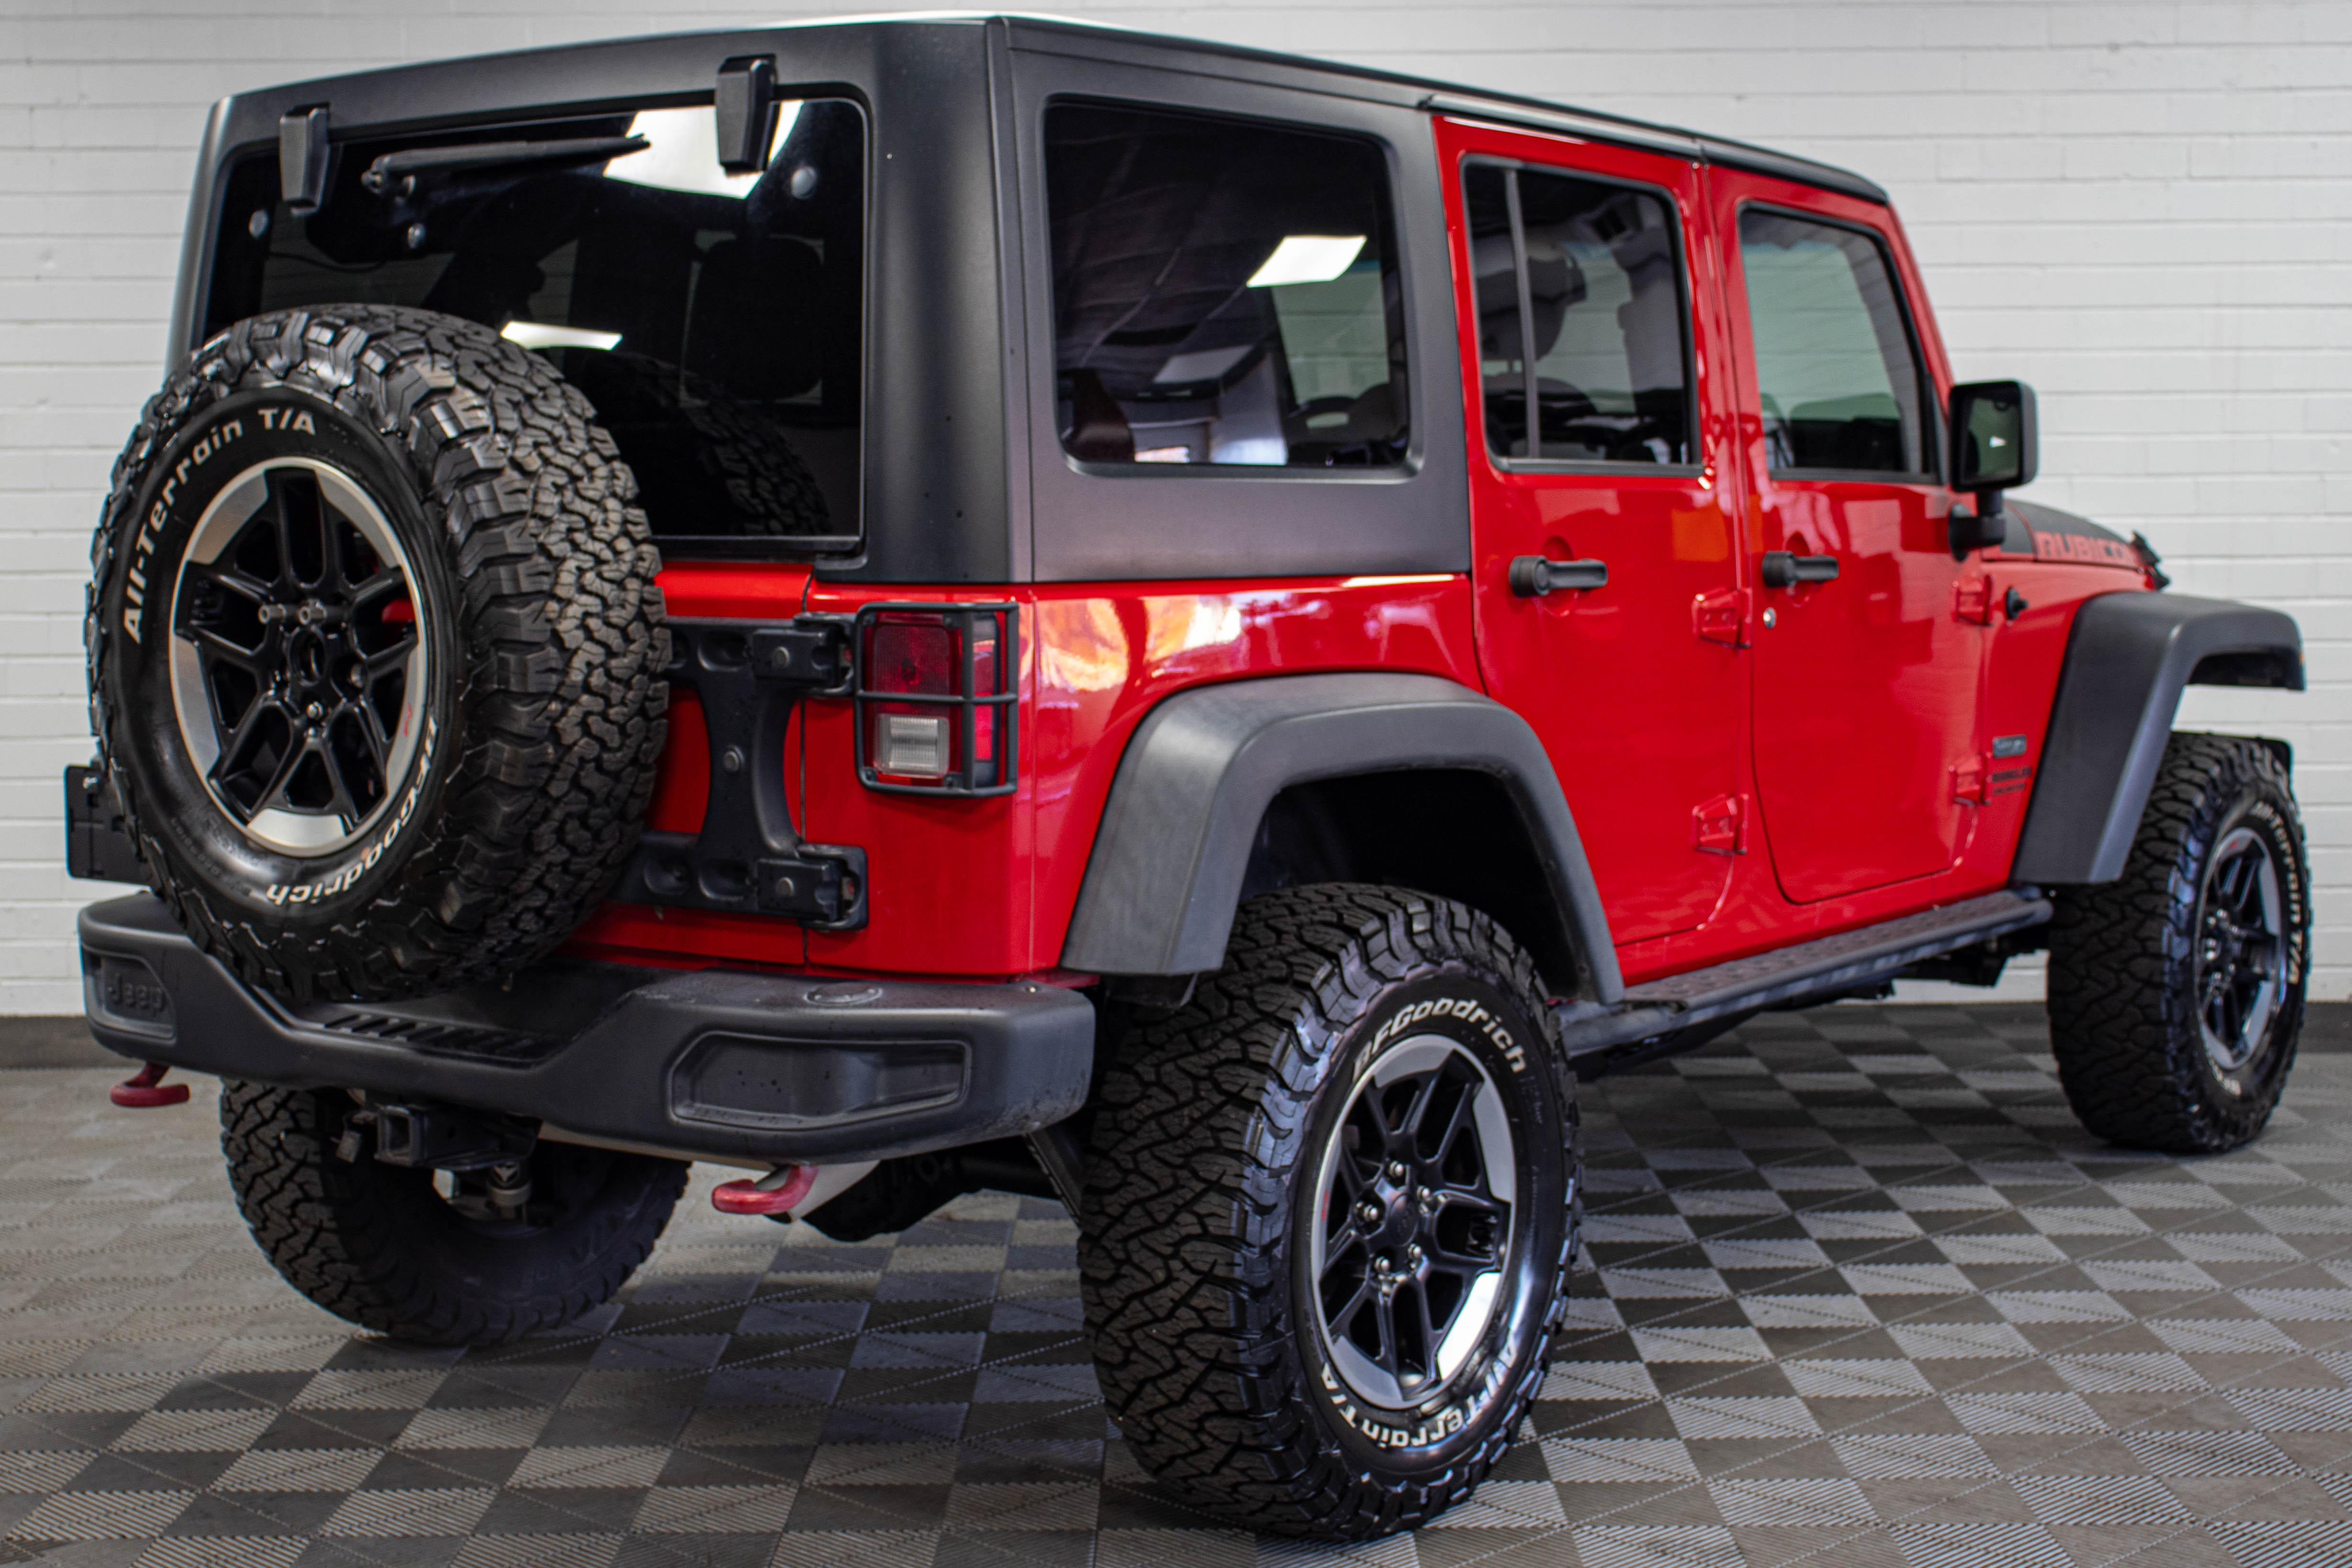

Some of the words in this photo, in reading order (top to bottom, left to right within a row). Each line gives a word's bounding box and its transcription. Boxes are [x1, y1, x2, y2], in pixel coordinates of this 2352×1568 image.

[123, 418, 244, 644] All-Terrain
[257, 407, 316, 435] T/A
[266, 716, 438, 906] BFGoodrich
[107, 972, 164, 1017] Jeep
[1352, 997, 1527, 1082] BFGoodrich
[1321, 1362, 1357, 1429] T/A
[1361, 1328, 1518, 1449] All-Terrain
